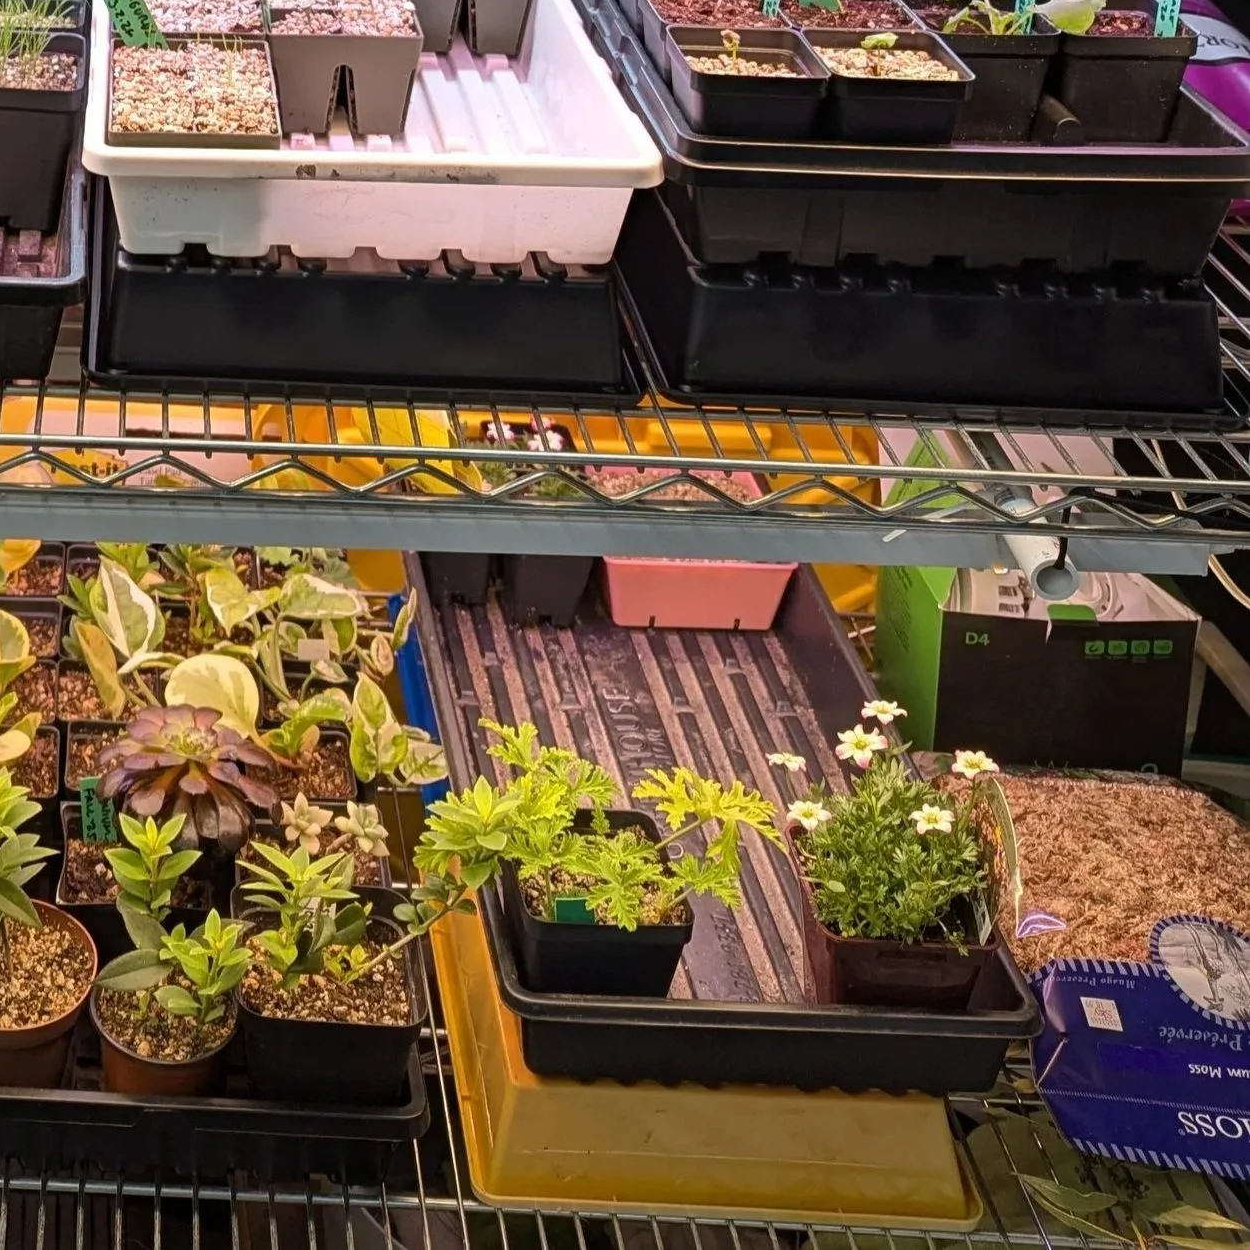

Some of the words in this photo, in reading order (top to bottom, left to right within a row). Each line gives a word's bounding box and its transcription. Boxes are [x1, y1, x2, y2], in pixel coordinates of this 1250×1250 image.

[965, 631, 991, 647] D4
[1100, 976, 1136, 989] Musgo
[1188, 1063, 1222, 1079] Moss
